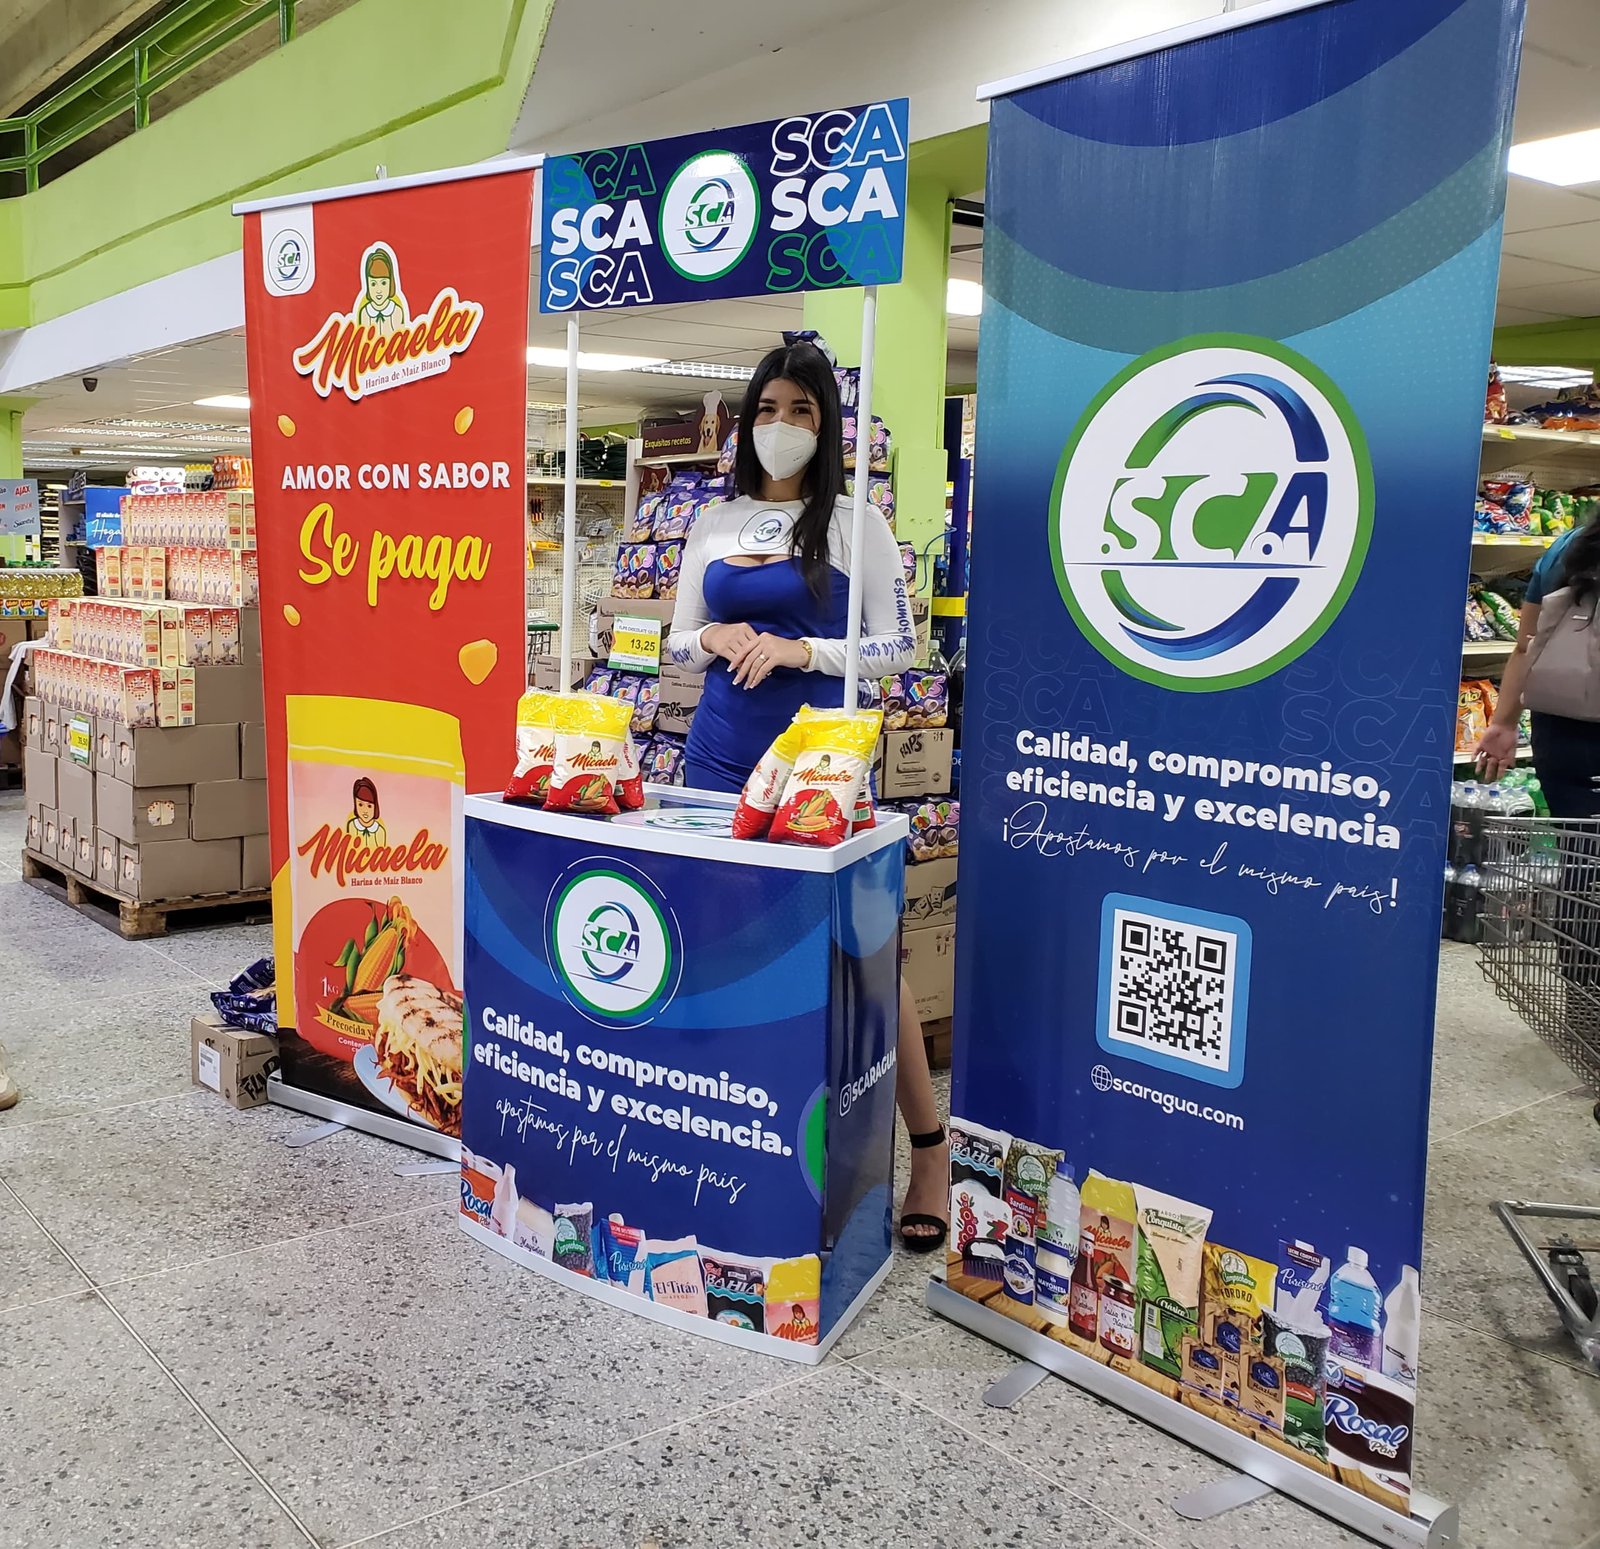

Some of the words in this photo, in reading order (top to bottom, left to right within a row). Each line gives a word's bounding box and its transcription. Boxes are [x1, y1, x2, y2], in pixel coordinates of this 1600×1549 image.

[769, 102, 906, 178] SCA
[553, 144, 657, 208] SCA
[770, 167, 900, 231] SCA
[551, 199, 652, 256] SCA
[684, 197, 736, 229] SCA
[547, 250, 654, 311] SCA
[766, 223, 899, 292] SCA
[297, 296, 478, 393] Micaela
[365, 376, 390, 390] Harina
[391, 370, 401, 382] de
[421, 357, 447, 373] Blanco
[671, 437, 692, 447] recetas
[14, 484, 32, 497] AJAX
[281, 464, 352, 491] AMOR
[358, 463, 410, 490] CON
[418, 461, 511, 490] SABOR
[1100, 471, 1328, 563] SCA
[299, 502, 360, 585] Se
[367, 530, 493, 611] paga
[893, 577, 913, 634] estamos
[630, 638, 656, 652] 13,25
[566, 752, 619, 771] Micaela
[1015, 729, 1139, 774] Calidad,
[1147, 747, 1391, 808] compromiso,
[1005, 767, 1156, 813] eficiencia
[1162, 790, 1186, 822] y
[1194, 797, 1401, 850] excelencia
[297, 823, 449, 888] Micaela
[350, 876, 374, 888] Harina
[374, 876, 383, 887] de
[400, 874, 424, 887] Blanco
[1142, 847, 1189, 874] por
[1199, 841, 1229, 876] el
[1237, 861, 1323, 897] mismo
[581, 922, 641, 961] SCA
[326, 1013, 367, 1037] Precocida
[481, 1006, 571, 1064] Calidad,
[575, 1044, 779, 1118] compromiso,
[851, 1046, 898, 1103] SCARAGUA
[473, 1041, 582, 1102] eficiencia
[587, 1084, 605, 1114] y
[610, 1093, 794, 1157] excelencia.
[1111, 1077, 1245, 1132] scaragua.com
[495, 1095, 570, 1151] apostamos
[570, 1124, 604, 1167] por
[606, 1123, 628, 1174] el
[626, 1147, 695, 1184] mismo
[459, 1177, 495, 1220] Rosal
[1008, 1196, 1036, 1215] Sardines
[1146, 1214, 1184, 1233] Conquista
[653, 1281, 667, 1294] El
[666, 1279, 699, 1295] Titán
[1037, 1277, 1067, 1294] MAYONESA
[1160, 1299, 1187, 1316] Clásico
[1326, 1393, 1409, 1448] Rosal
[1369, 1439, 1398, 1460] Plus
